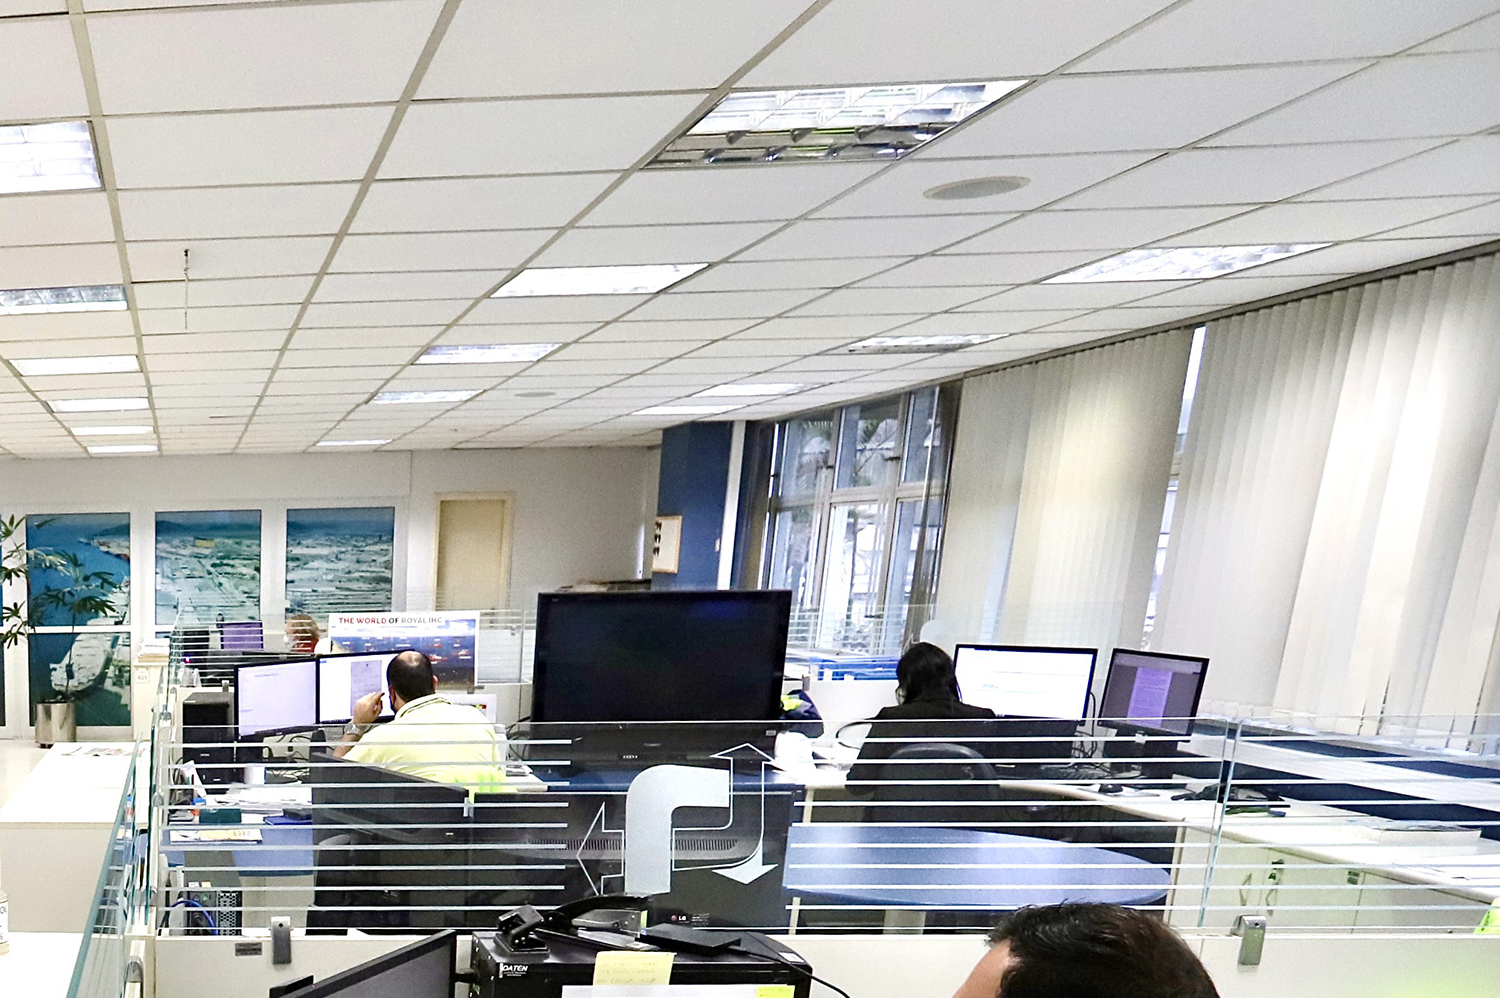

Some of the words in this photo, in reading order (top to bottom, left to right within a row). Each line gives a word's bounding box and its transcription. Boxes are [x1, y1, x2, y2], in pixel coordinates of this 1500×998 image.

[401, 616, 427, 624] ROYAL
[428, 616, 443, 624] IHC
[502, 964, 529, 972] DATEN
